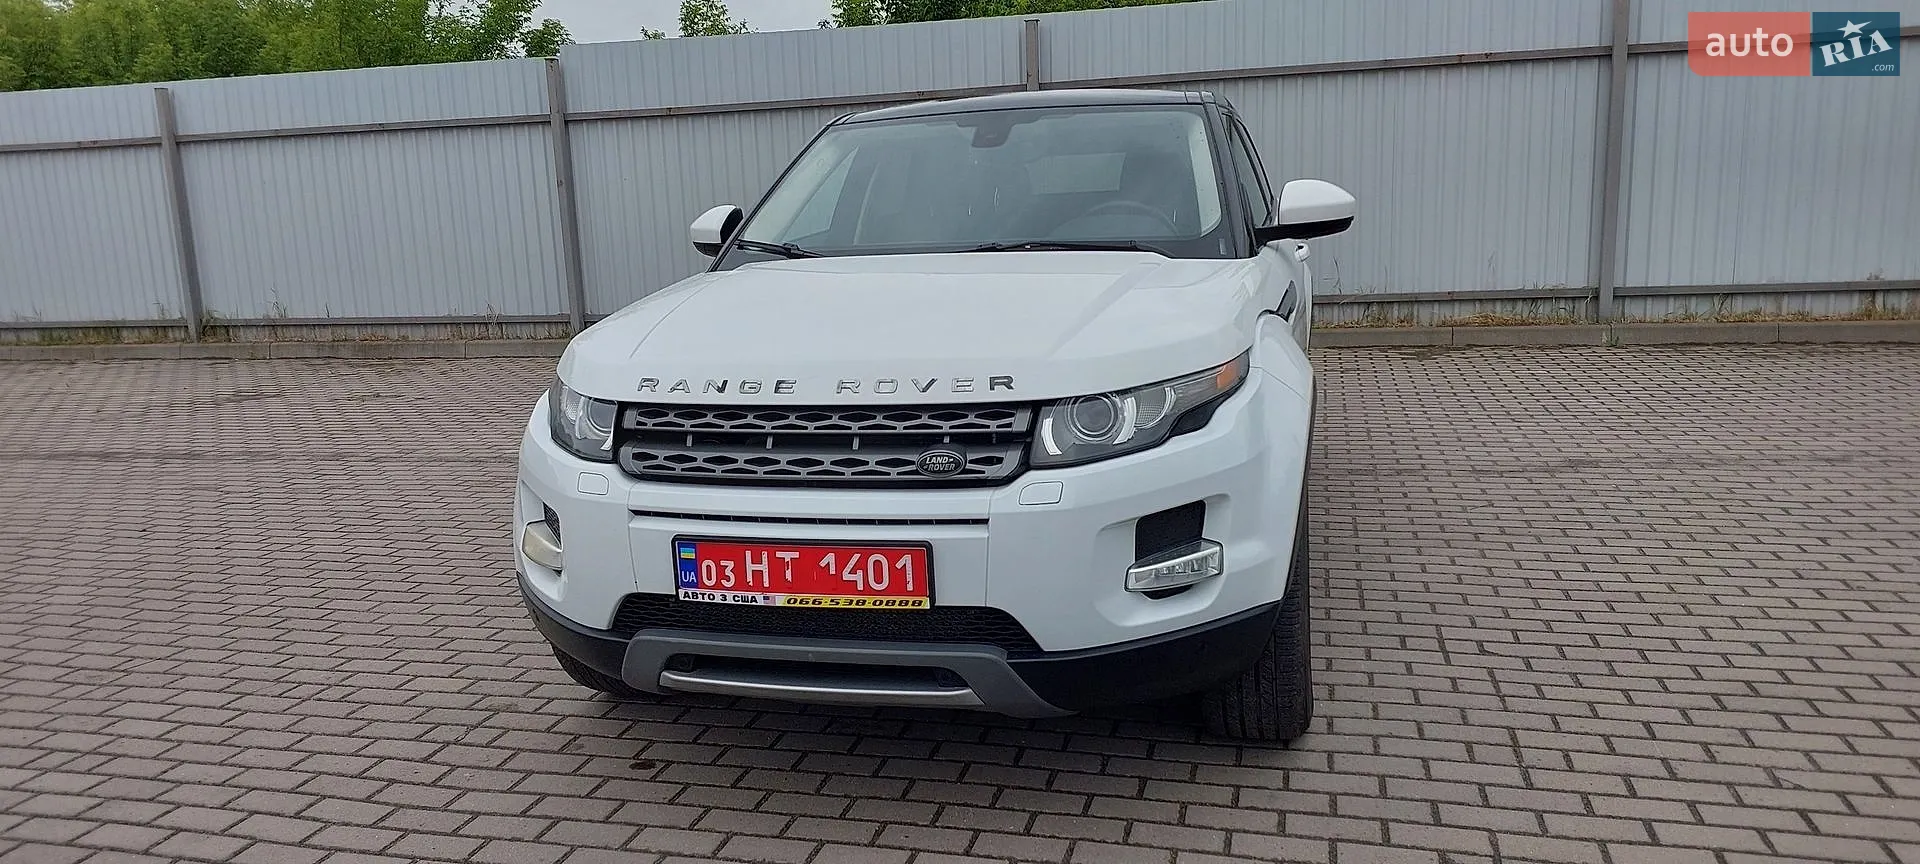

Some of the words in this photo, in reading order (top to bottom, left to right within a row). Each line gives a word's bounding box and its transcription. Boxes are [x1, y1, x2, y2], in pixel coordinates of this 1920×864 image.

[637, 377, 797, 394] RANGE
[836, 375, 1015, 393] ROVER
[927, 463, 956, 472] ROVER
[681, 570, 697, 583] UA
[701, 559, 735, 588] 03
[818, 552, 914, 591] 1401
[682, 591, 716, 602] АВТО
[732, 594, 759, 604] США
